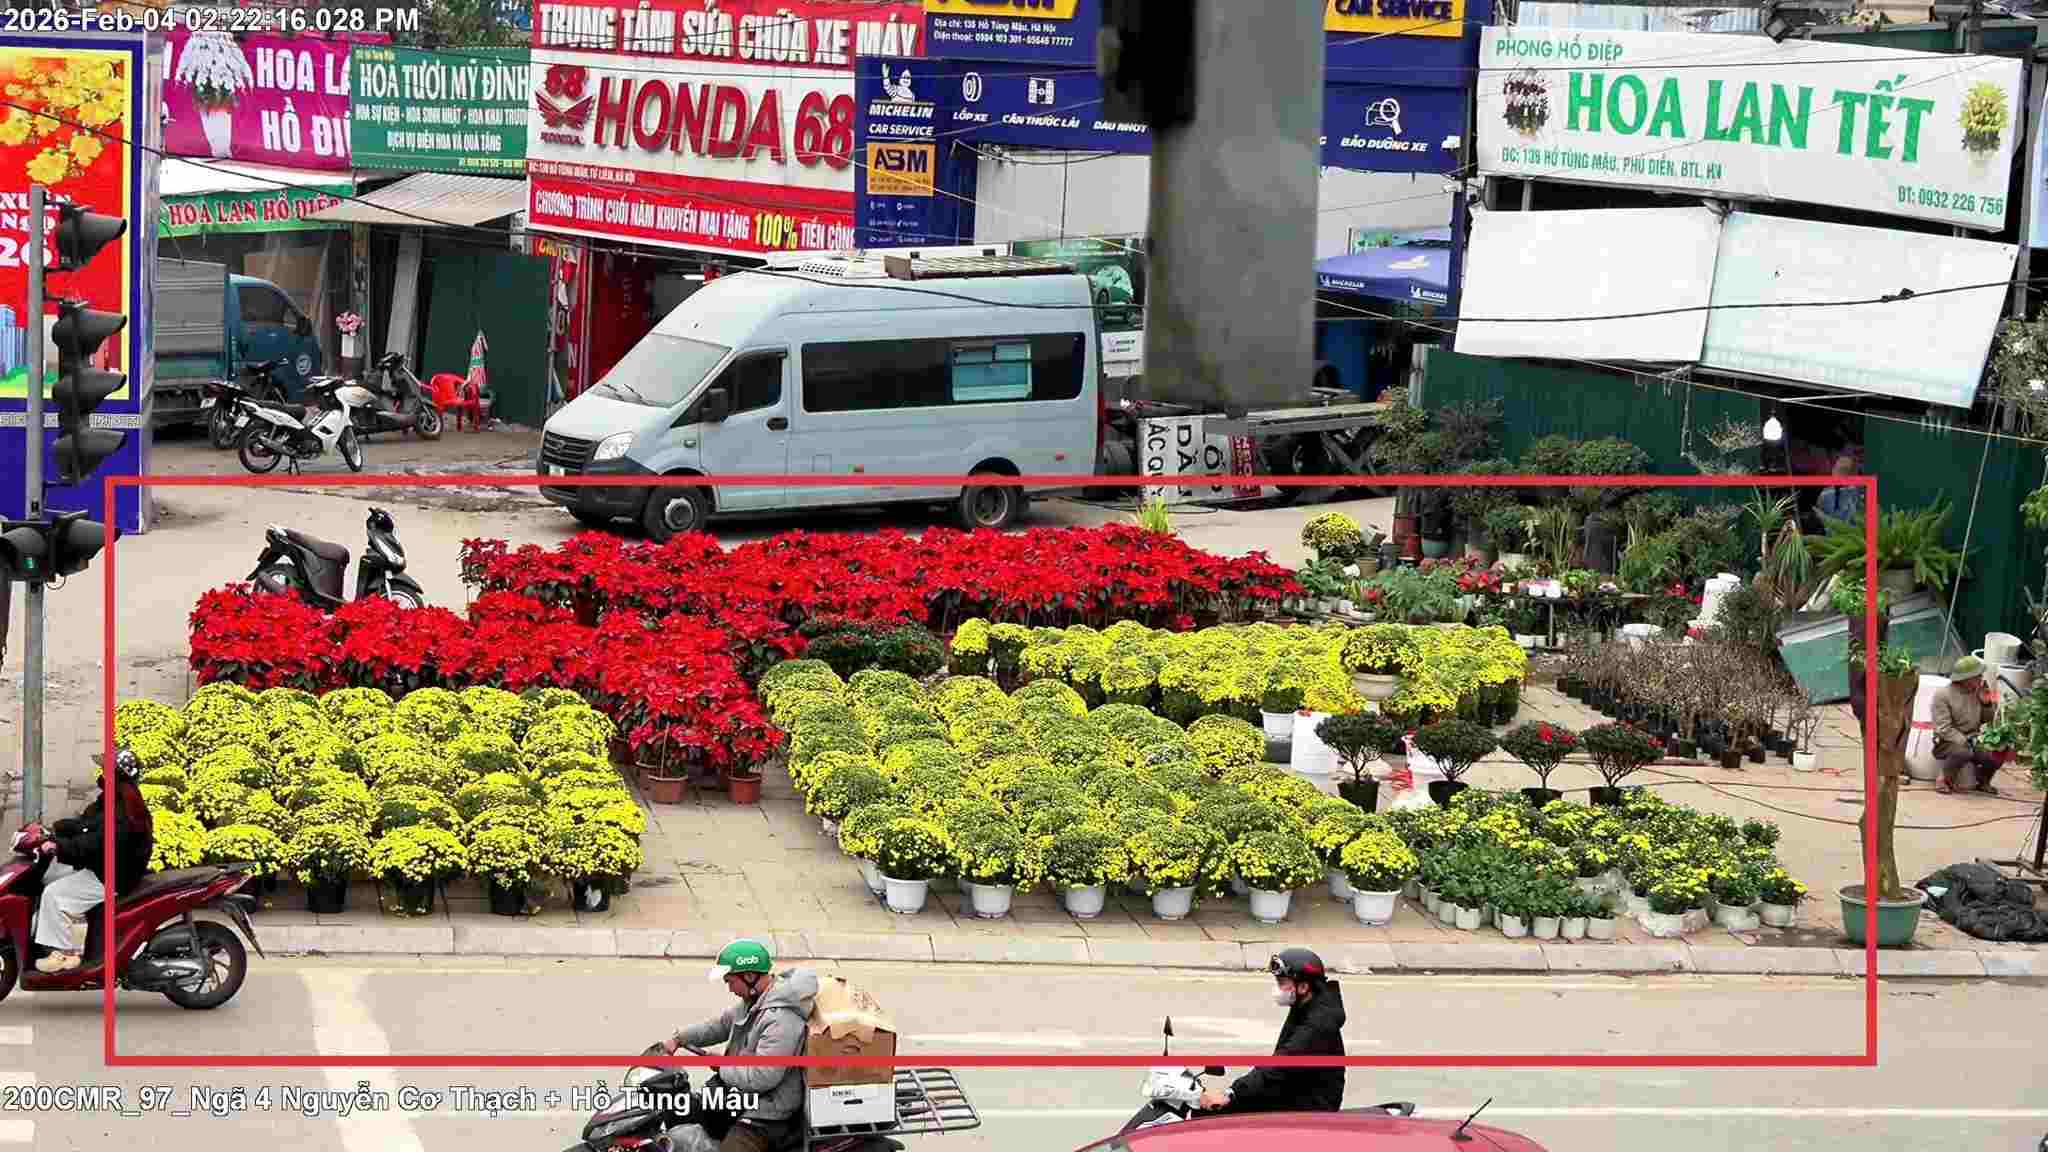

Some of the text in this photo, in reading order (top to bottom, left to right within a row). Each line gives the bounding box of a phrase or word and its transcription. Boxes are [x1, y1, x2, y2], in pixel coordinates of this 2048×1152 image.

[539, 0, 917, 65] TRUNG TÂM SỬA CHỮA XE MÁY
[1496, 40, 1553, 58] PHONG
[256, 47, 315, 93] HOA
[360, 56, 529, 101] HOA TƯƠI MỸ ĐÌNH
[261, 96, 301, 153] HỒ
[593, 76, 855, 170] HONDA 68
[869, 104, 934, 119] MICHELIN
[1566, 72, 1936, 162] HOA LAN TẾT
[869, 123, 935, 136] CAR SERVICE
[1341, 134, 1365, 148] BẢO
[1411, 142, 1428, 152] XE
[874, 148, 928, 174] ABM
[168, 202, 213, 226] HOA
[216, 199, 257, 224] LAN
[1919, 188, 1948, 208] 0932
[1952, 193, 1975, 212] 226
[754, 211, 799, 250] 100%
[735, 955, 759, 966] Grab
